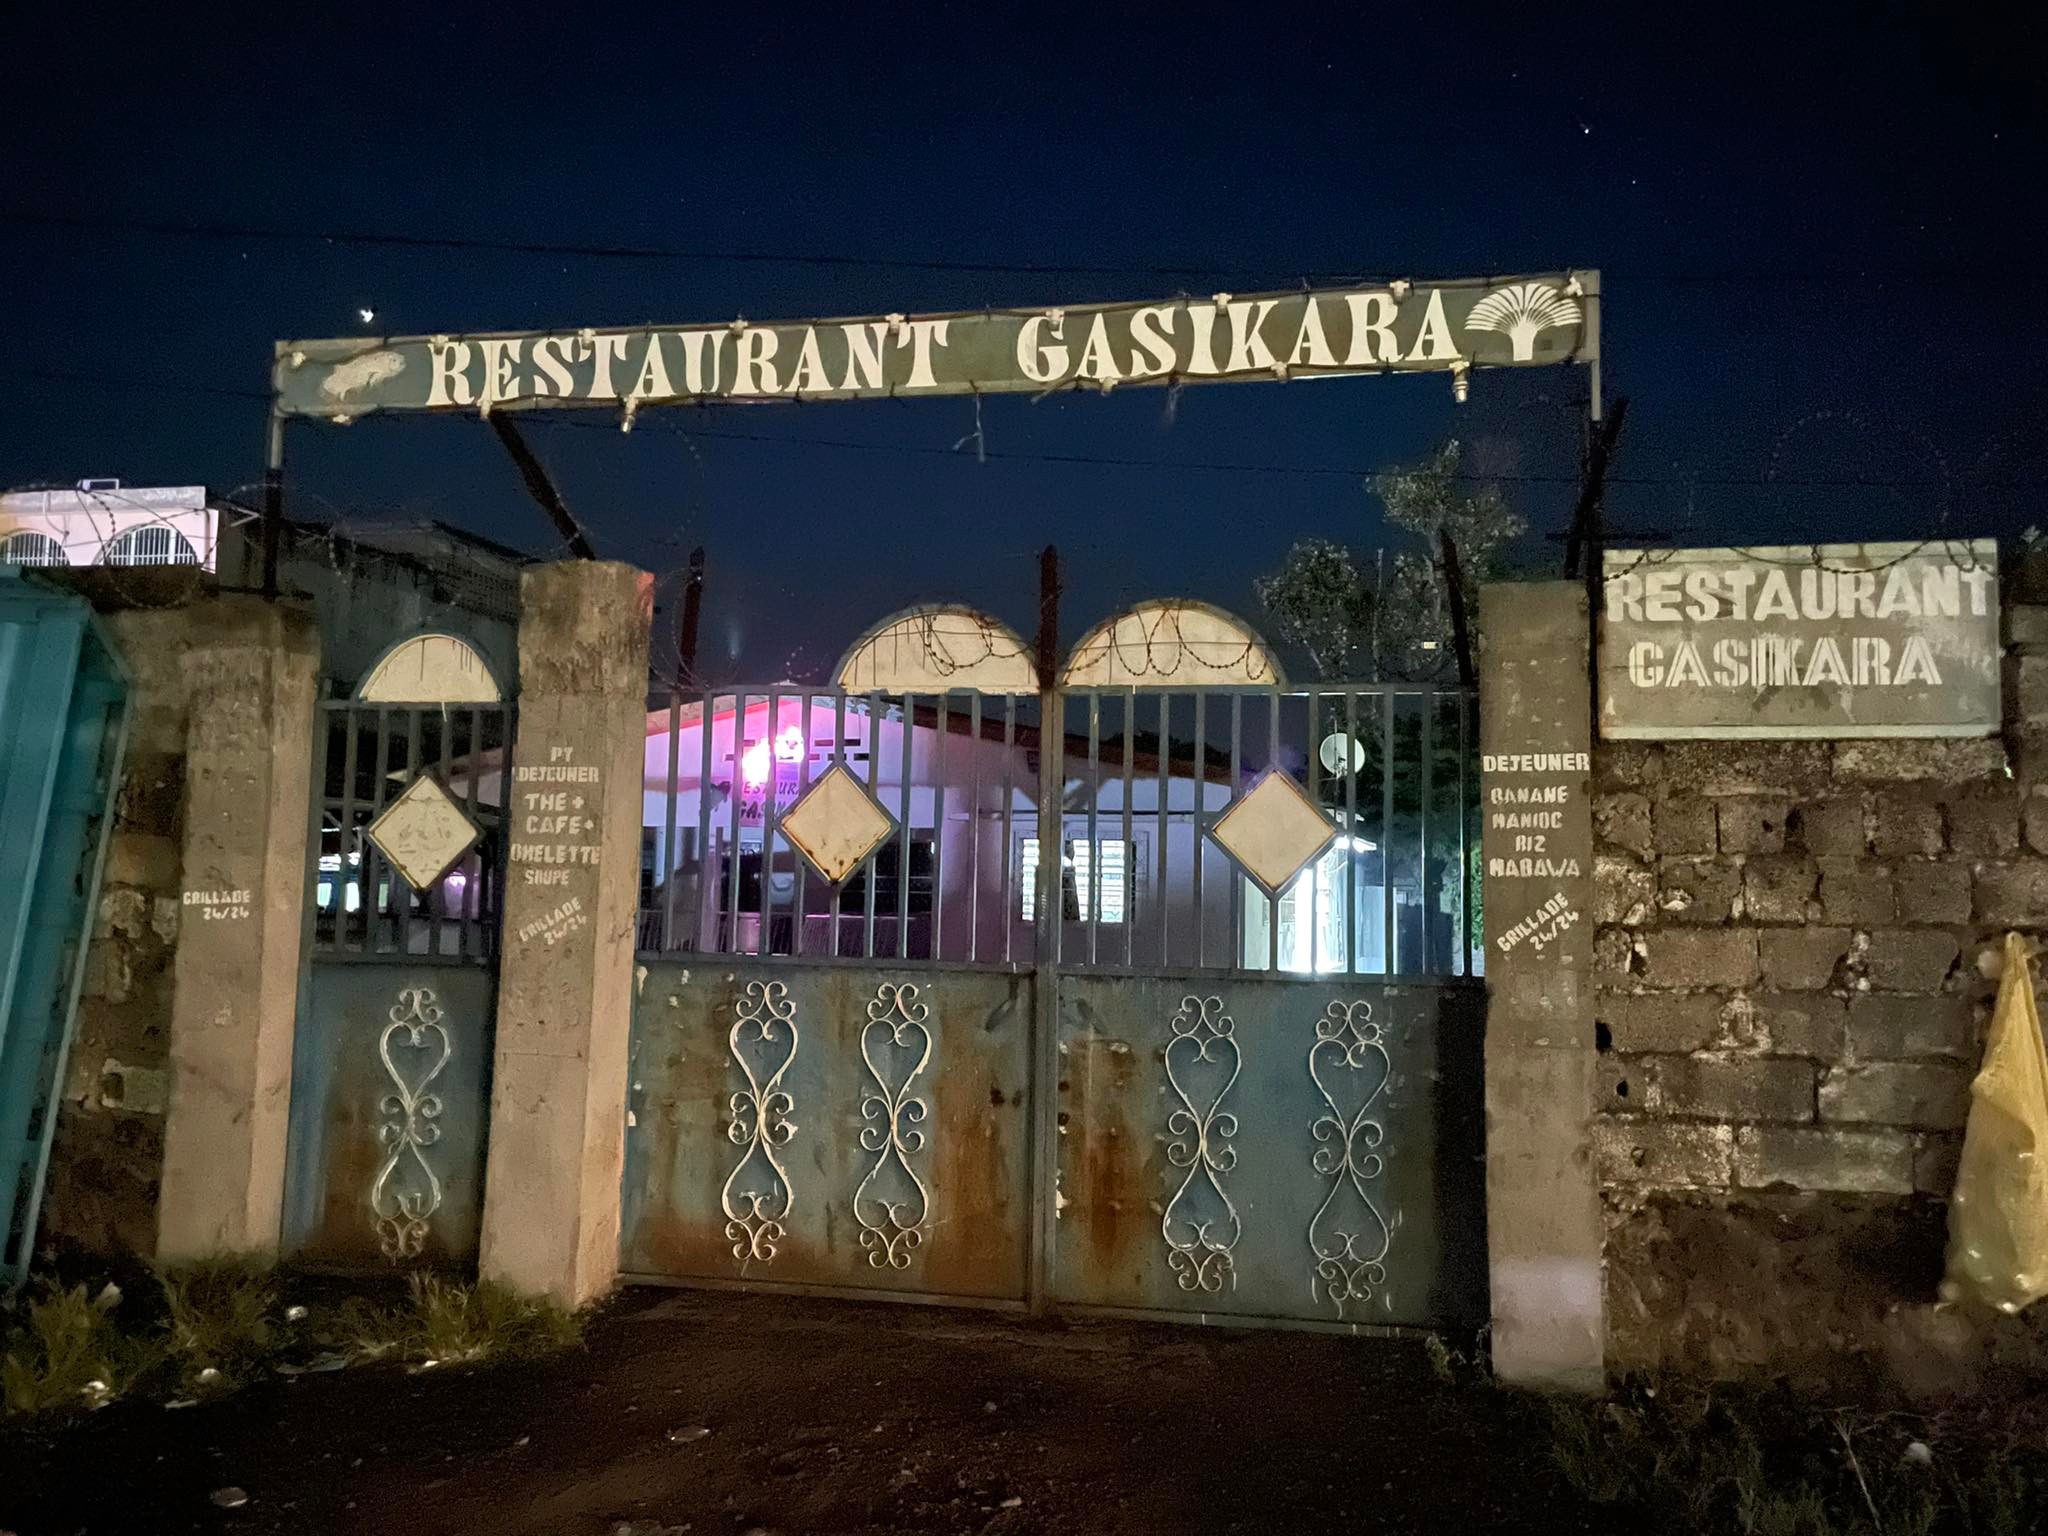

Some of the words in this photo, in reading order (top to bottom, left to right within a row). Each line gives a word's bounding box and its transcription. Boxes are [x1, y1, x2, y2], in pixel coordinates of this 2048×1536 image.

[425, 319, 950, 407] RESTAURANT
[1017, 288, 1460, 382] GASIKARA
[1606, 564, 1994, 622] RESTAURANT
[1629, 634, 1943, 688] GASIKARA
[1483, 753, 1590, 772] DEJEUNER
[516, 766, 599, 783] DEJEUNER
[524, 793, 566, 811] THE
[1491, 785, 1568, 804] BANANE
[526, 815, 582, 834] CAFE
[1492, 811, 1563, 829] MANIOC
[1515, 835, 1546, 852] RIZ
[183, 890, 250, 904] GRILLADE
[1497, 892, 1569, 951] GRILLADE
[1530, 910, 1580, 950] 24/24
